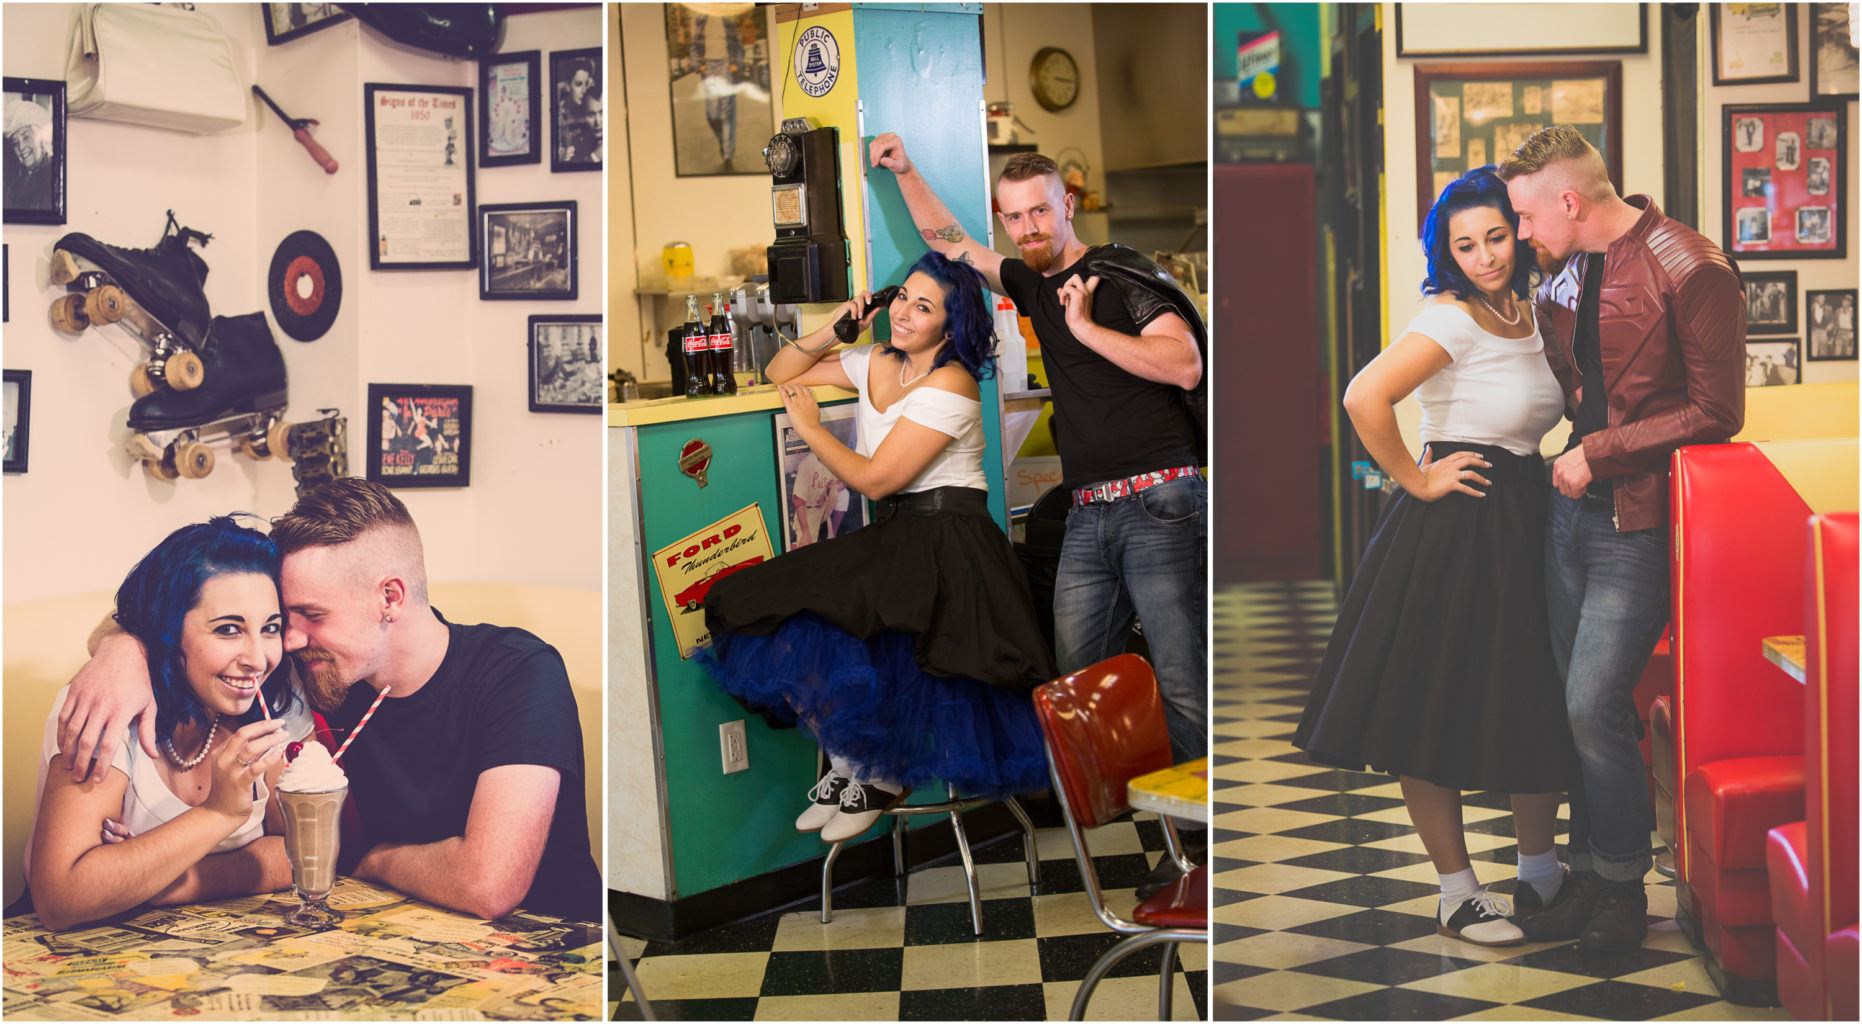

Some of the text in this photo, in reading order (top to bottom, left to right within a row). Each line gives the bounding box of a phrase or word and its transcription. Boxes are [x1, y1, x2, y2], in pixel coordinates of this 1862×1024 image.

[799, 29, 830, 47] PUBLIC
[797, 65, 837, 95] TELEPHONE
[408, 98, 416, 107] of
[418, 98, 429, 108] the
[432, 97, 457, 109] Times
[410, 110, 431, 121] 1950
[666, 523, 742, 568] FORD
[680, 529, 758, 576] Thunderbird
[695, 632, 712, 645] NE
